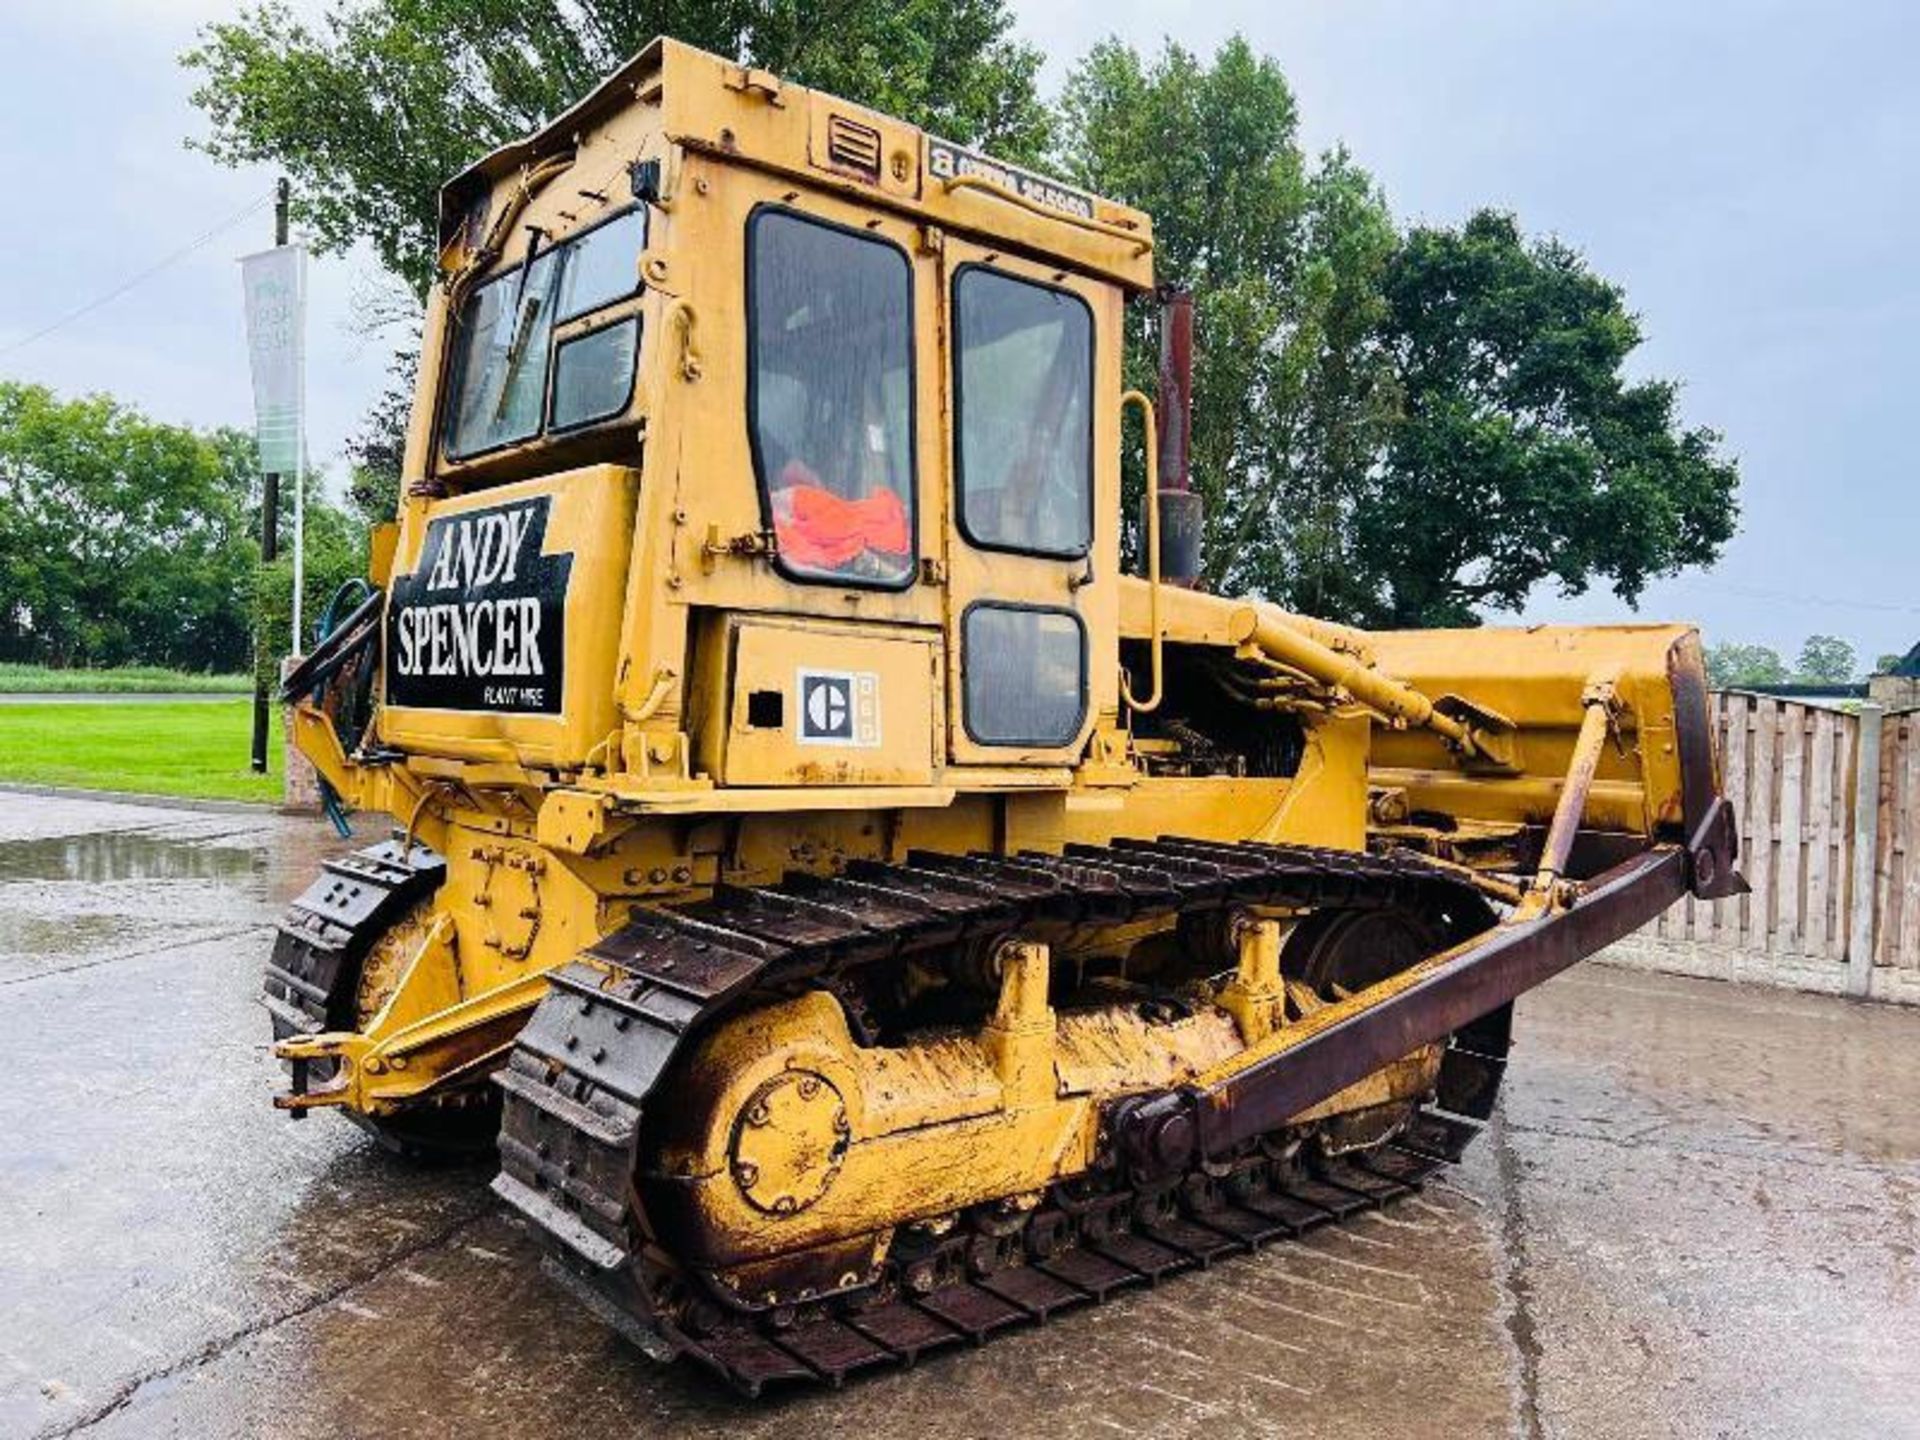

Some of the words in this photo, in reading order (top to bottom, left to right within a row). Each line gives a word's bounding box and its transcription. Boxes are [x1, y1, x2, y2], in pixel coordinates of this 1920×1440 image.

[427, 508, 536, 595] ANDY
[398, 597, 544, 676] SPENCER
[484, 686, 518, 705] PLANT
[520, 687, 544, 707] HIRE
